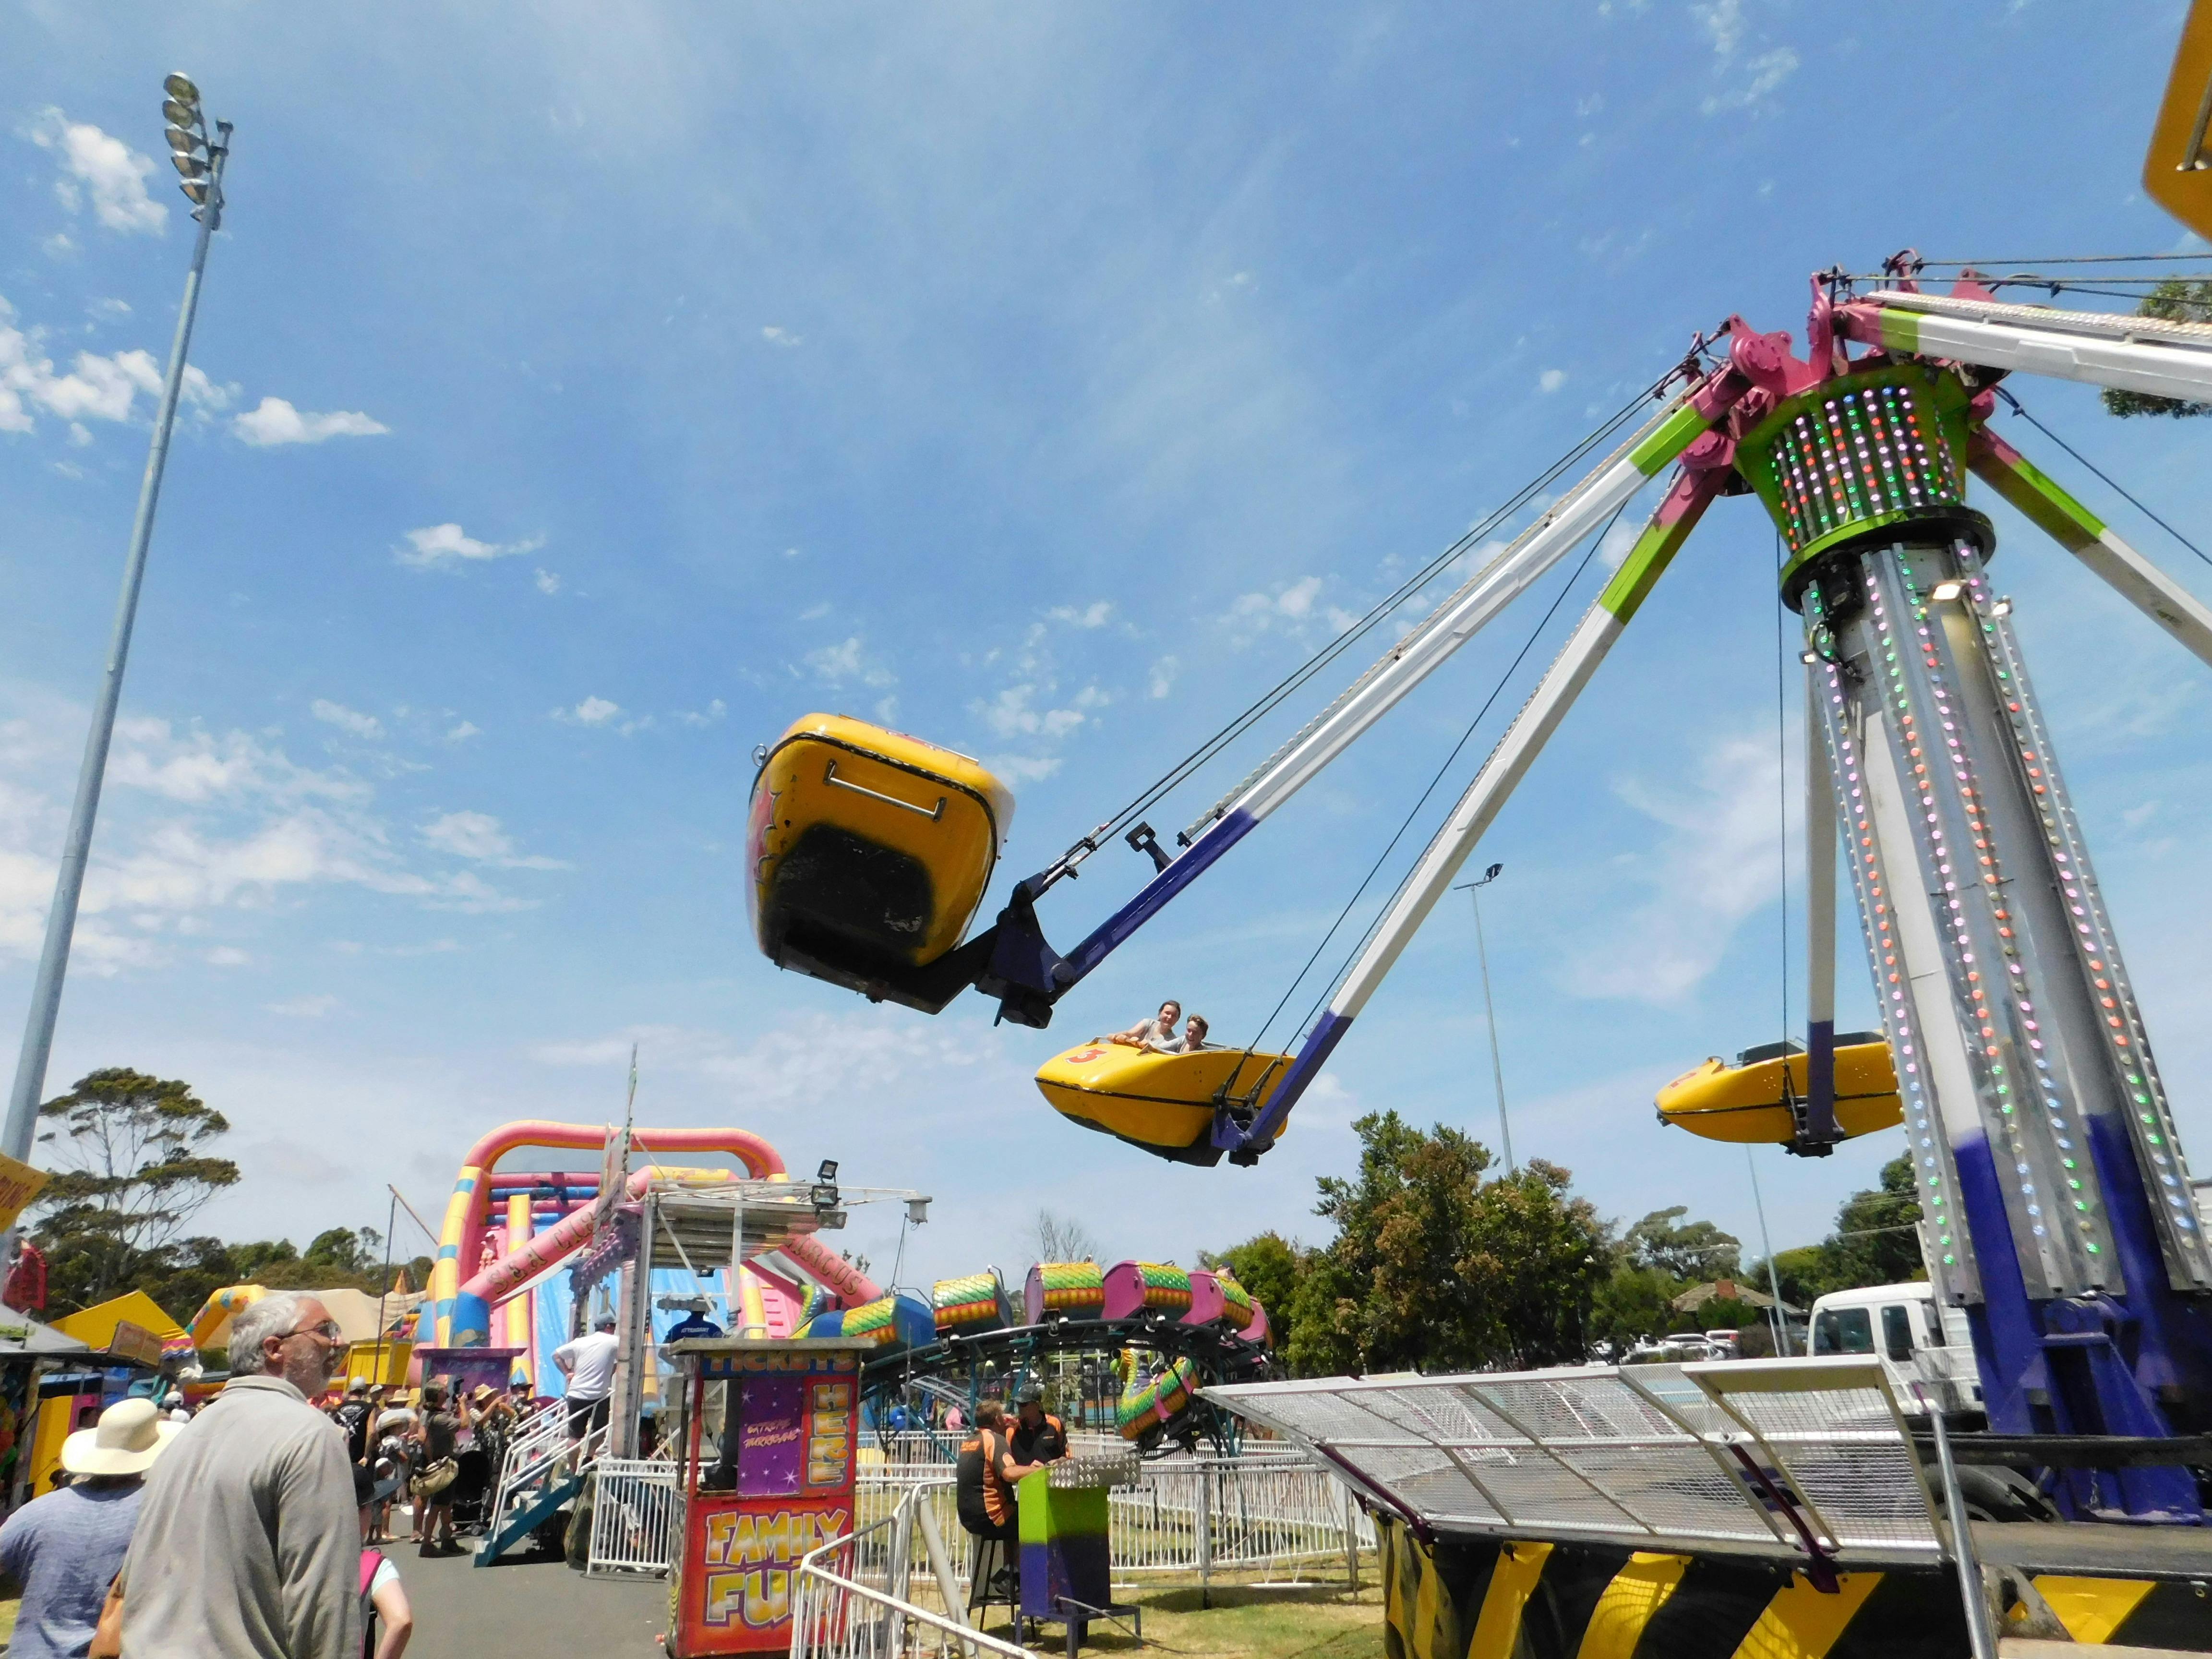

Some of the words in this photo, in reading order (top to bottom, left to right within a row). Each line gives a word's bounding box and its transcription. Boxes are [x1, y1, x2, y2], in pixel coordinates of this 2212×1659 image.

[1065, 1048, 1107, 1064] 3
[787, 1234, 863, 1295] IRCUS
[808, 1384, 850, 1484] HERE
[705, 1508, 848, 1565] FAMILY
